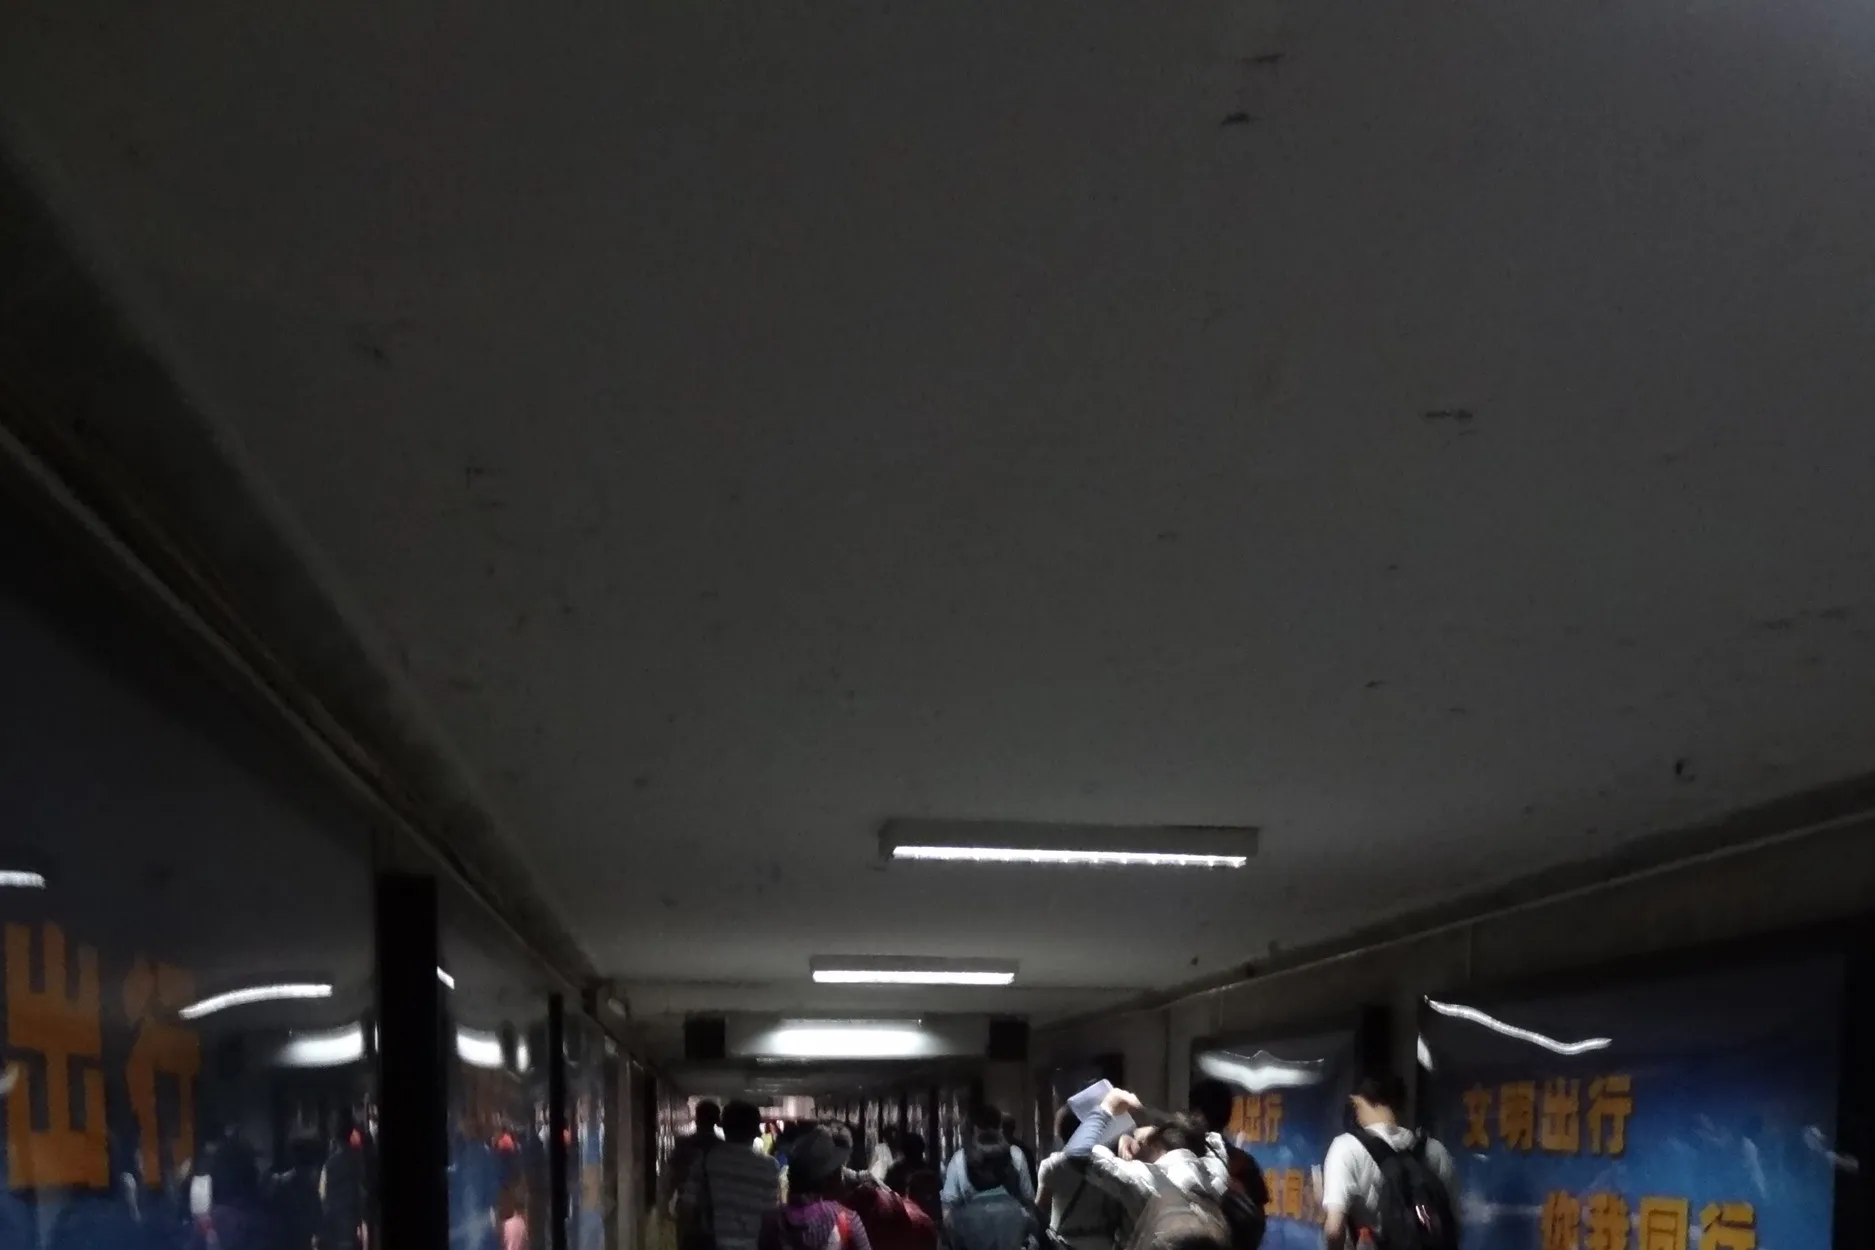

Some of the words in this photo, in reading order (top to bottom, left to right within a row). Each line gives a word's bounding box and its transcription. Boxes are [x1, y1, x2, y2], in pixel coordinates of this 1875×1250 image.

[3, 920, 200, 1190] 出行
[1461, 1074, 1634, 1154] 文明出行
